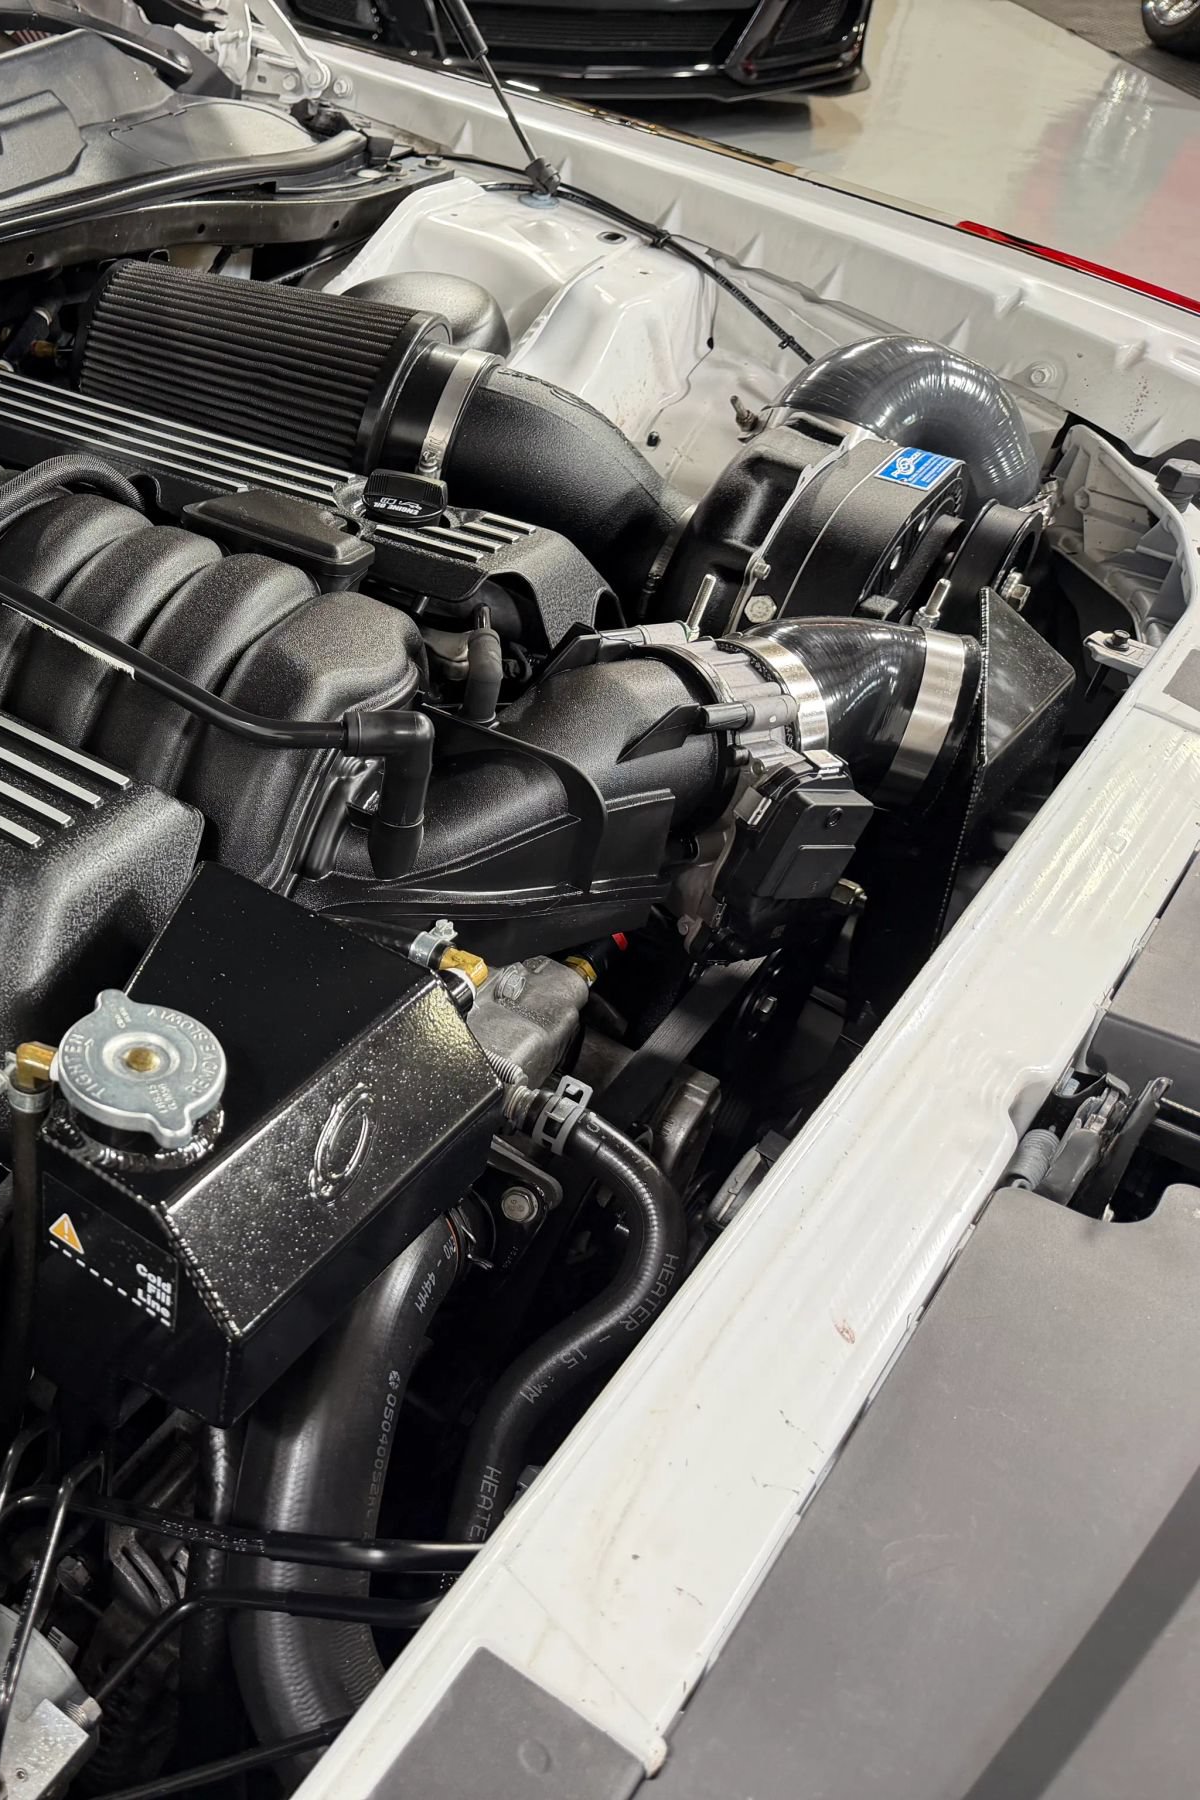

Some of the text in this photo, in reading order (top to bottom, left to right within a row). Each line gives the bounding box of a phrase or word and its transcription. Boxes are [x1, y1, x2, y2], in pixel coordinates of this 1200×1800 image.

[64, 1032, 107, 1099] TIGHTEN
[135, 1263, 172, 1295] Cold
[136, 1288, 171, 1319] Line
[146, 1282, 171, 1307] Fill
[620, 1252, 680, 1331] HEATER
[468, 1465, 502, 1542] HEATE
